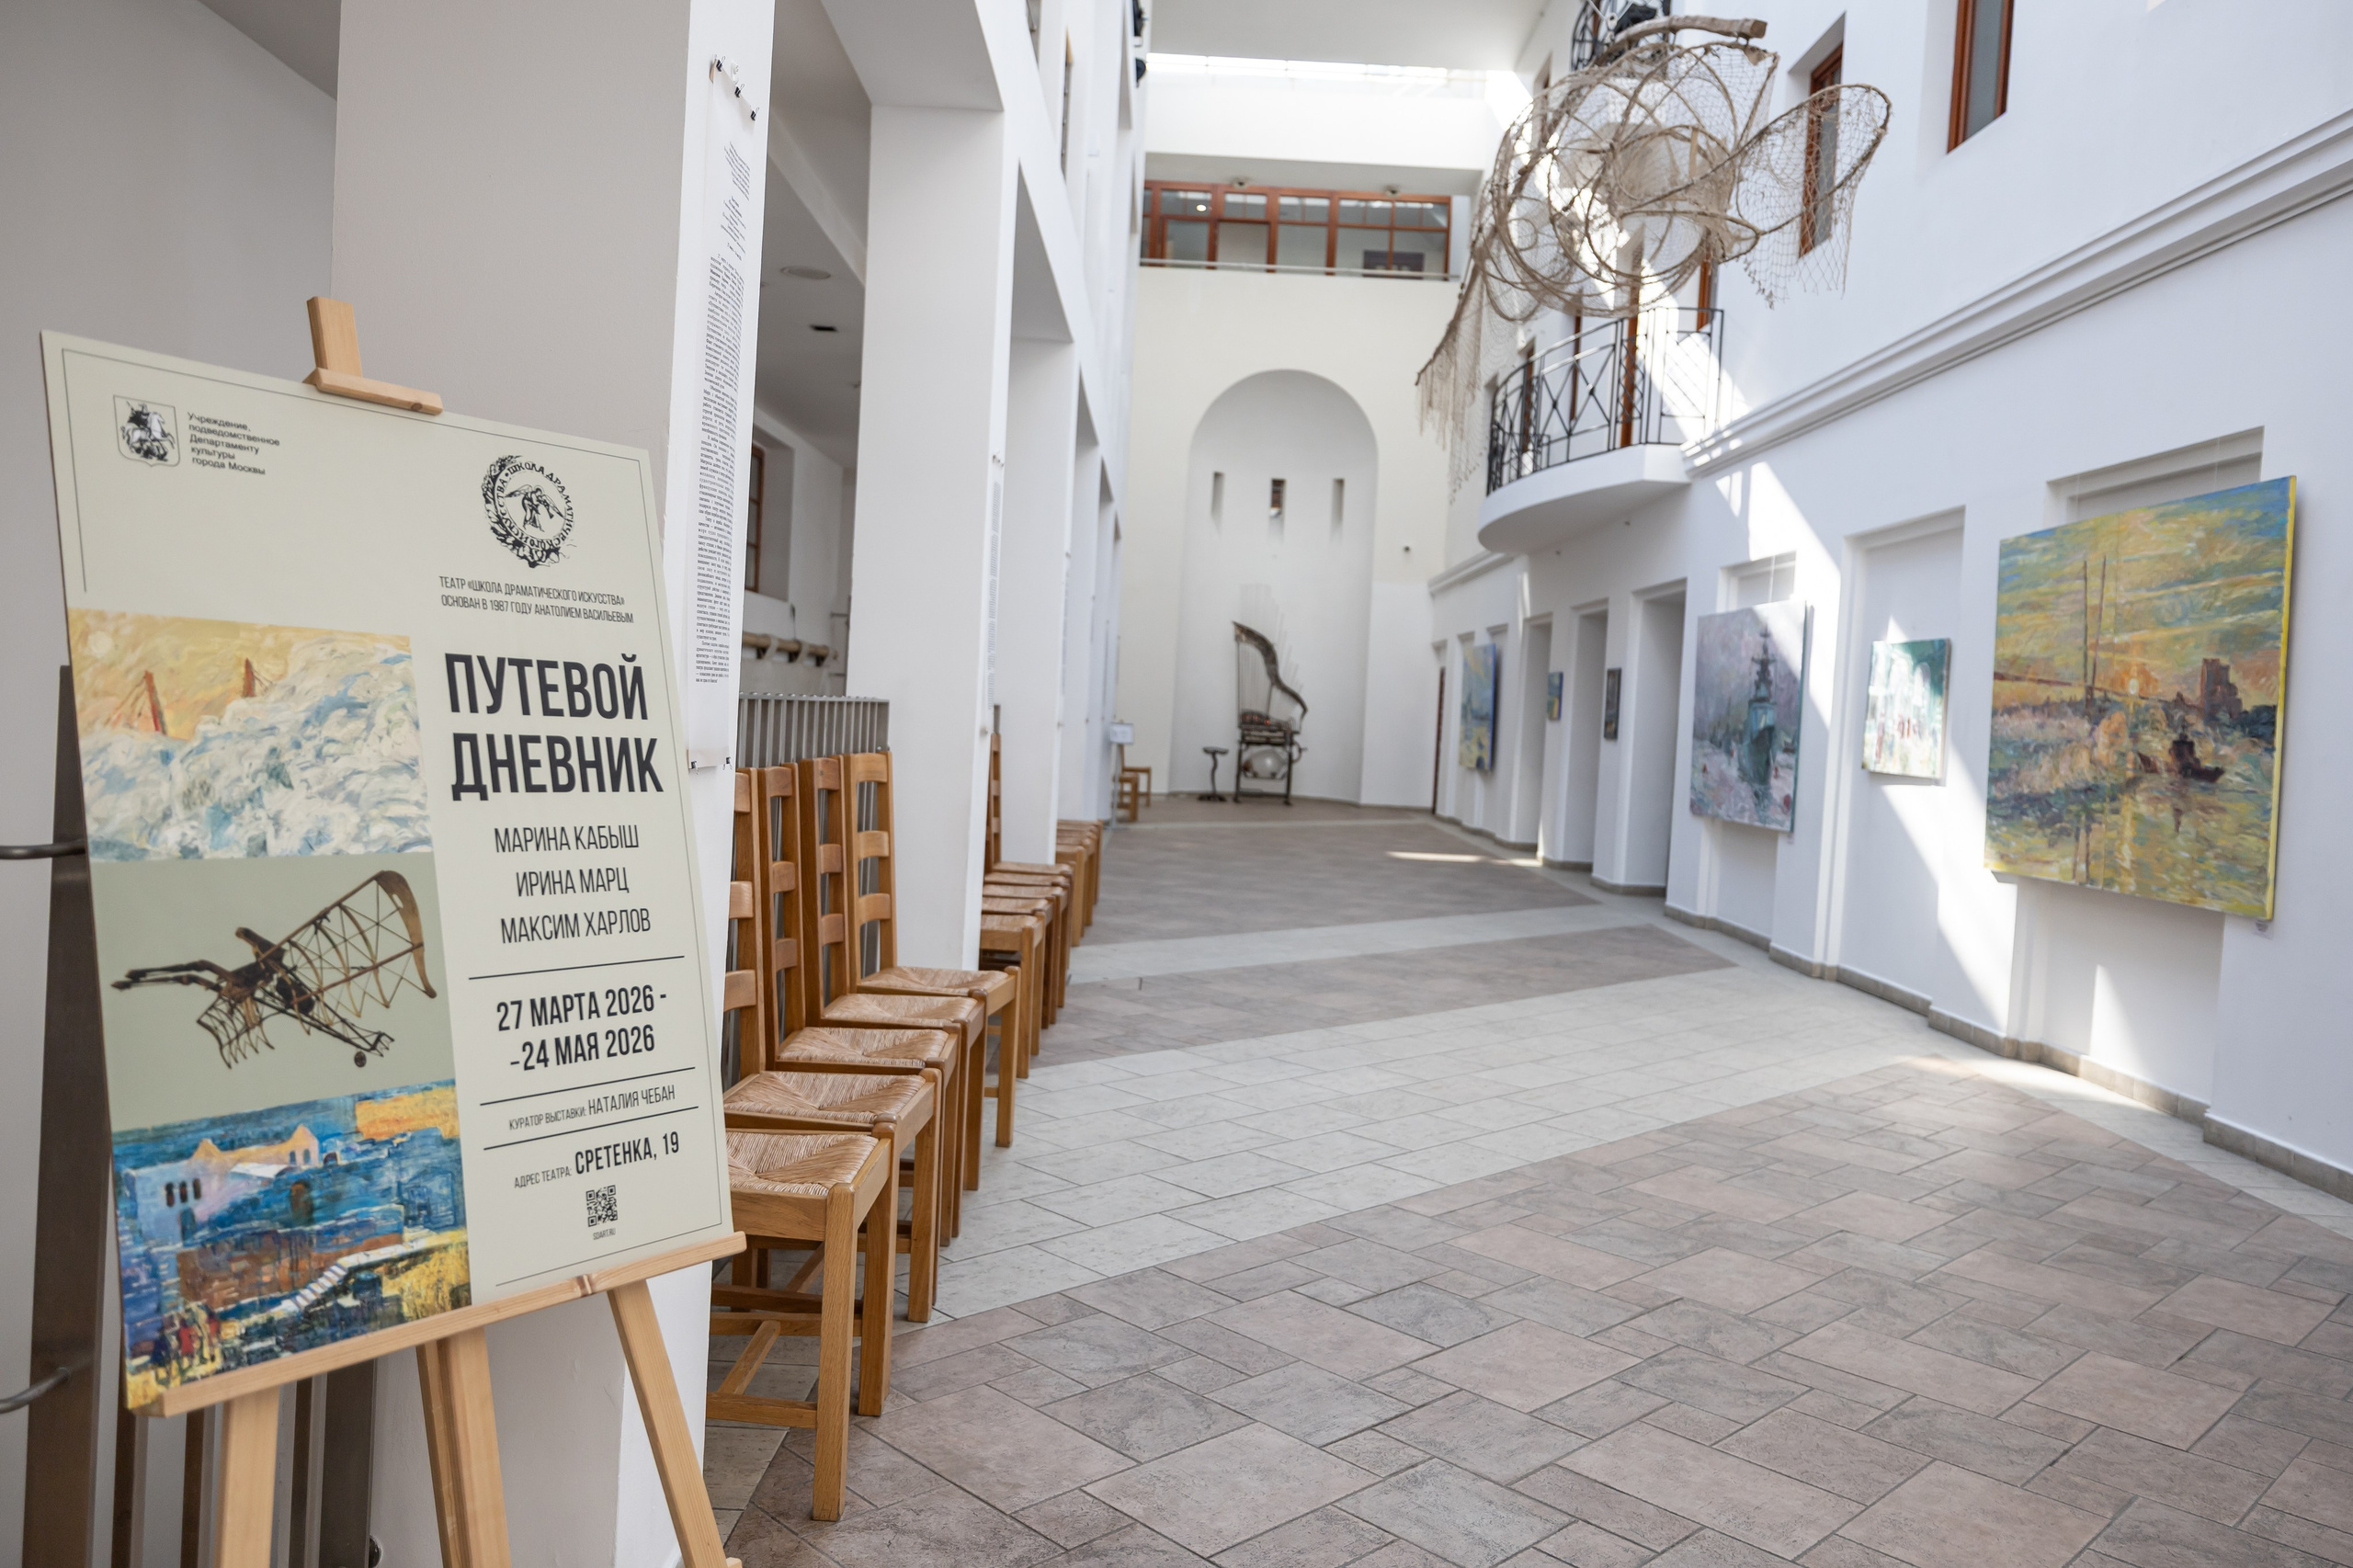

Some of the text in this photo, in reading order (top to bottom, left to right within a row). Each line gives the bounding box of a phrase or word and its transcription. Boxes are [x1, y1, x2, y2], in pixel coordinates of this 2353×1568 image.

[188, 424, 280, 446] подведомственное
[189, 434, 259, 455] Департаменту
[190, 446, 235, 460] культуры
[192, 457, 266, 475] города Москвы
[507, 461, 545, 475] ШКОЛА
[439, 575, 625, 607] ТЕАТР «ШКОЛА ДРАМАТИЧЕСКОГО ИСКУССТВА»
[441, 595, 634, 623] ОСНОВАН В 1987 ГОДУ АНАТОЛИЕМ ВАСИЛЬЕВЫМ
[445, 653, 648, 721] ПУТЕВОЙ
[451, 733, 664, 801] ДНЕВНИК
[494, 824, 640, 853] МАРИНА КАБЫШ
[516, 867, 630, 897] ИРИНА МАРЦ
[501, 908, 651, 944] МАКСИМ ХАРЛОВ
[496, 1000, 523, 1031] 27
[529, 991, 601, 1028] МАРТА
[605, 984, 655, 1017] 2026
[554, 1032, 600, 1066] МАЯ
[605, 1024, 655, 1058] 2026
[508, 1085, 676, 1131] КУРАТОР ВЫСТАВКИ: НАТАЛИЯ ЧЕБАН
[514, 1131, 680, 1189] АДРЕС ТЕАТРА: СРЕТЕНКА, 19
